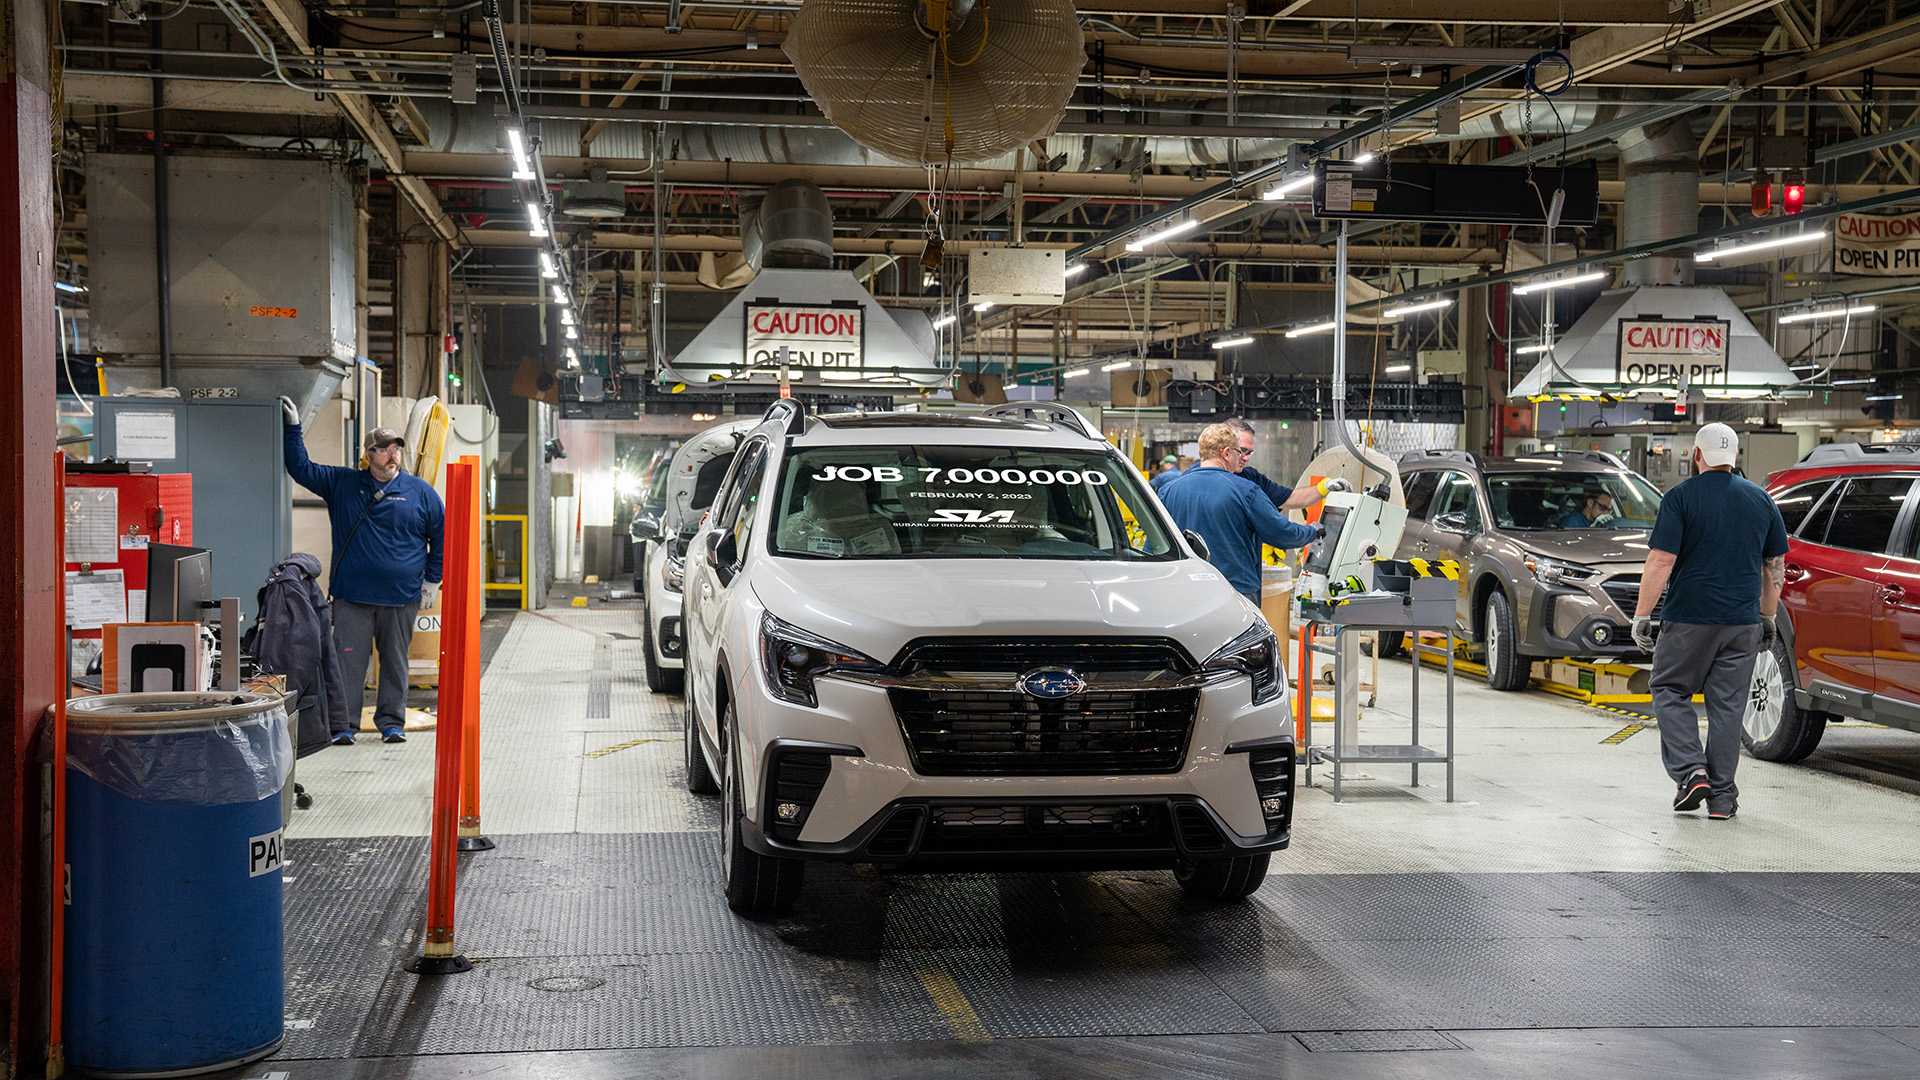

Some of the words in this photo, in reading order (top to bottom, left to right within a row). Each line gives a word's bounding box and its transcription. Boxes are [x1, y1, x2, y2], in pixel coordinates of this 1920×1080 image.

[1838, 215, 1920, 238] CAUTION
[1840, 248, 1888, 269] OPEN
[1894, 249, 1920, 268] PIT
[753, 312, 854, 336] CAUTION
[1627, 327, 1721, 349] CAUTION
[822, 352, 855, 367] PIT
[1627, 363, 1684, 384] OPEN
[1690, 364, 1722, 384] PIT
[191, 388, 213, 398] PSF
[1720, 437, 1728, 449] B
[812, 465, 904, 482] JOB
[918, 467, 1108, 486] 7,000,000
[910, 491, 983, 499] FEBRUARY
